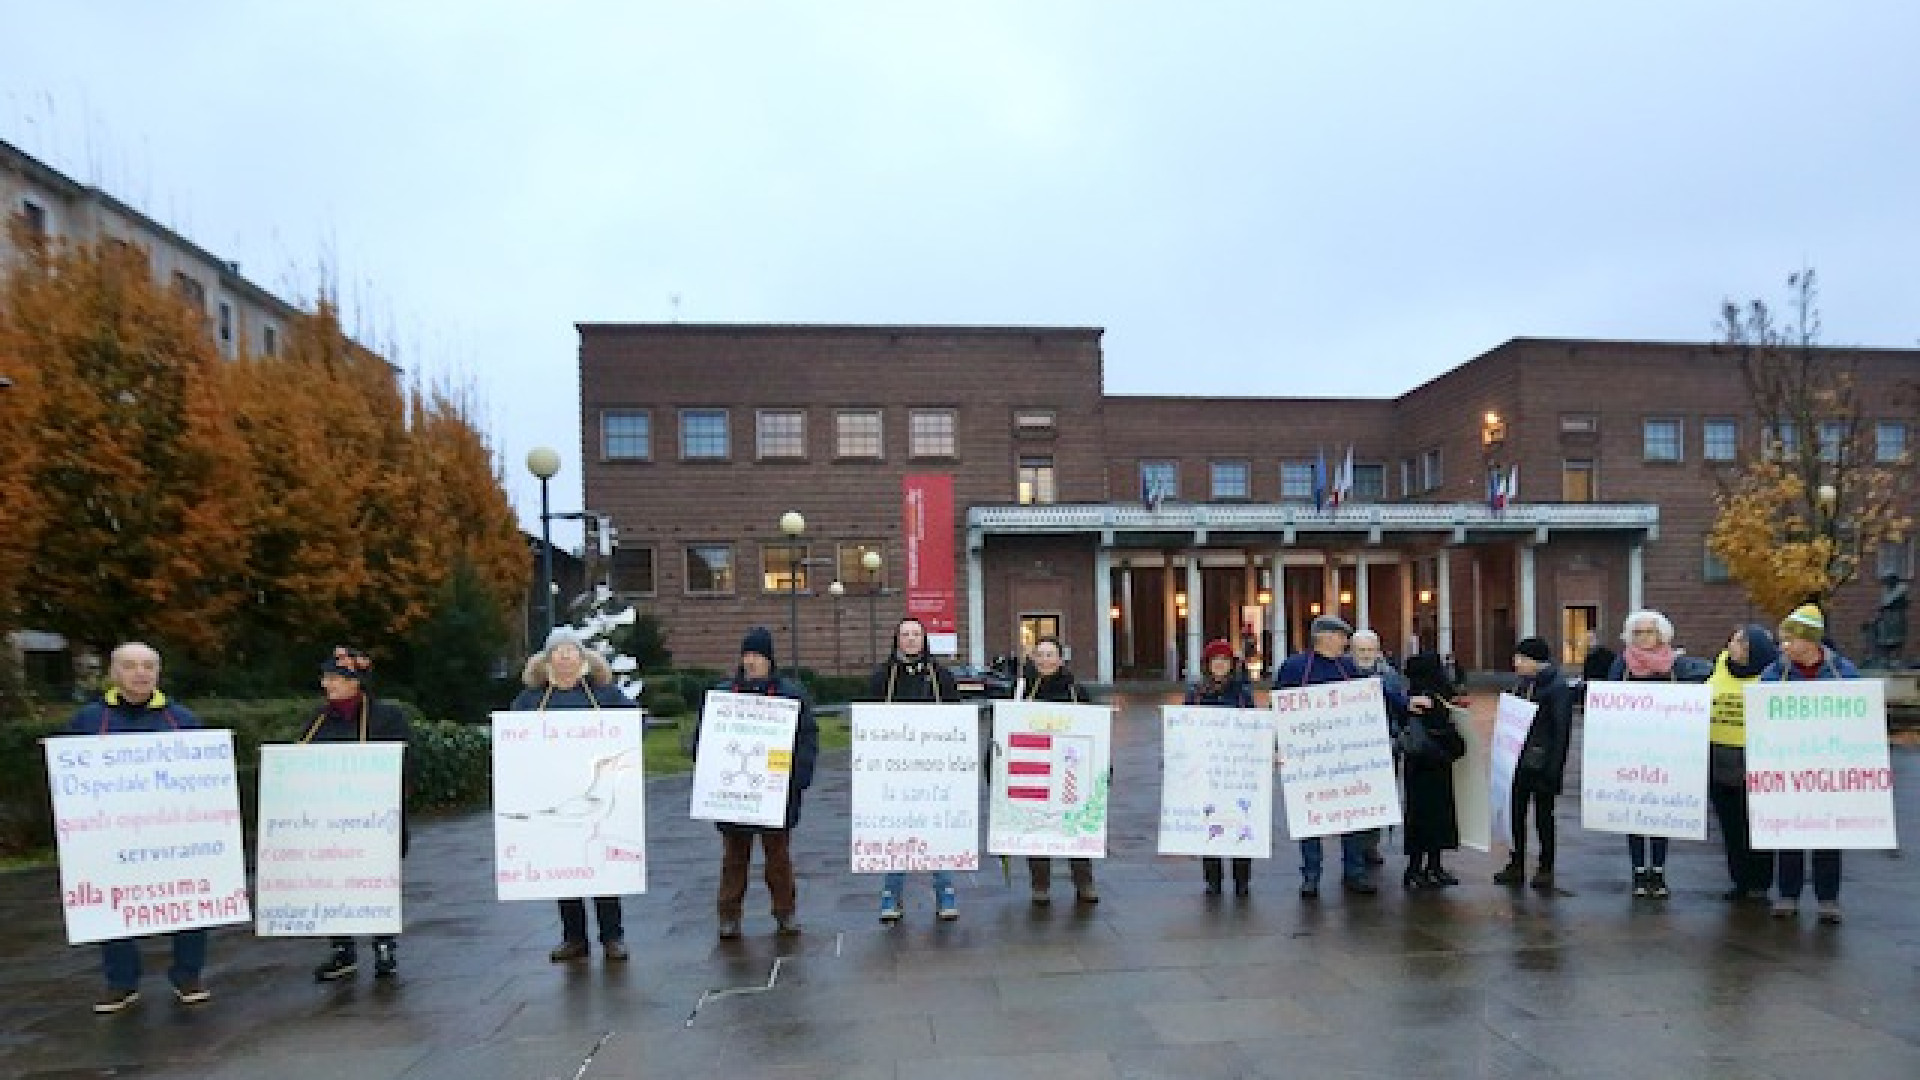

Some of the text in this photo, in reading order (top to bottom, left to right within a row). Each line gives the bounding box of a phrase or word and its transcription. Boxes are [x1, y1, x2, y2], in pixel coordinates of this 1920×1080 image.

[1590, 692, 1654, 712] NUOVO
[1769, 695, 1867, 721] ABBIAMO
[566, 719, 622, 739] canto
[1616, 765, 1669, 784] soldi
[1747, 768, 1896, 793] NON VOGLIAMO
[117, 840, 225, 864] serviranno
[67, 878, 211, 913] alla prossima
